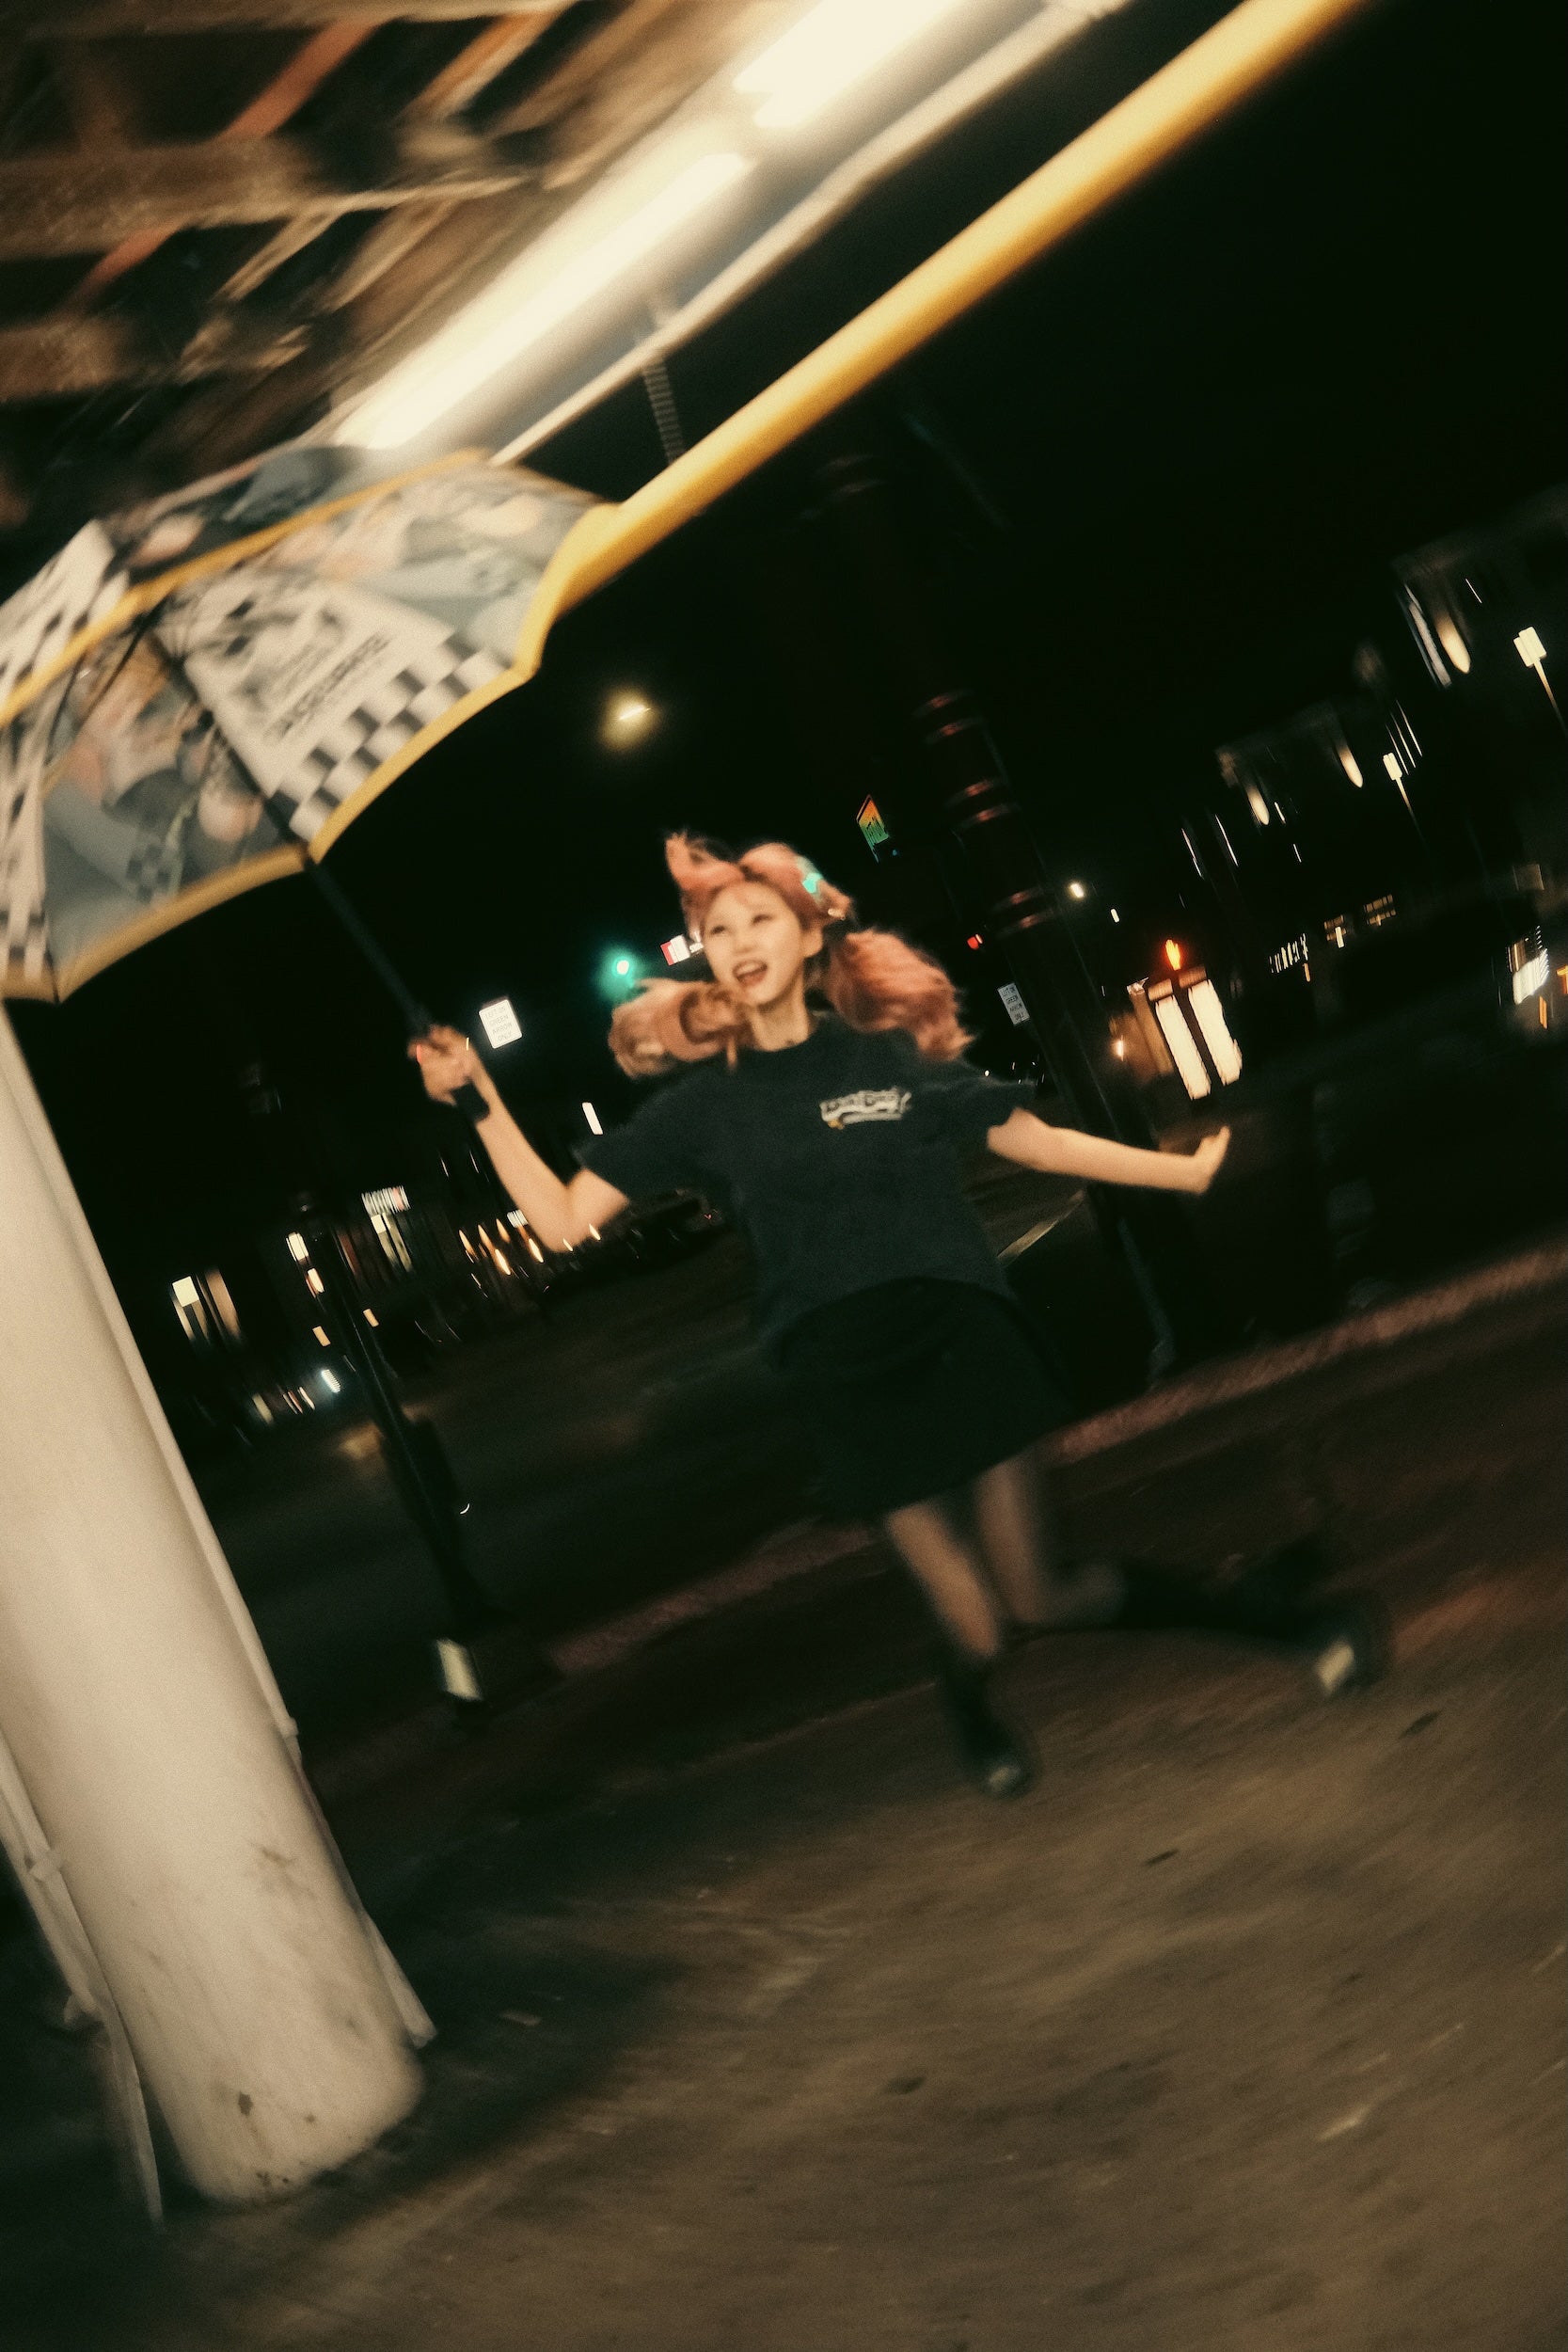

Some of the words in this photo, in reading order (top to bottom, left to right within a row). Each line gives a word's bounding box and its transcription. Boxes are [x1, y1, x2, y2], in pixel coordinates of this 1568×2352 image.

[490, 1014, 509, 1026] GREEN
[492, 1022, 513, 1034] ARROW
[498, 1032, 512, 1041] ONLY
